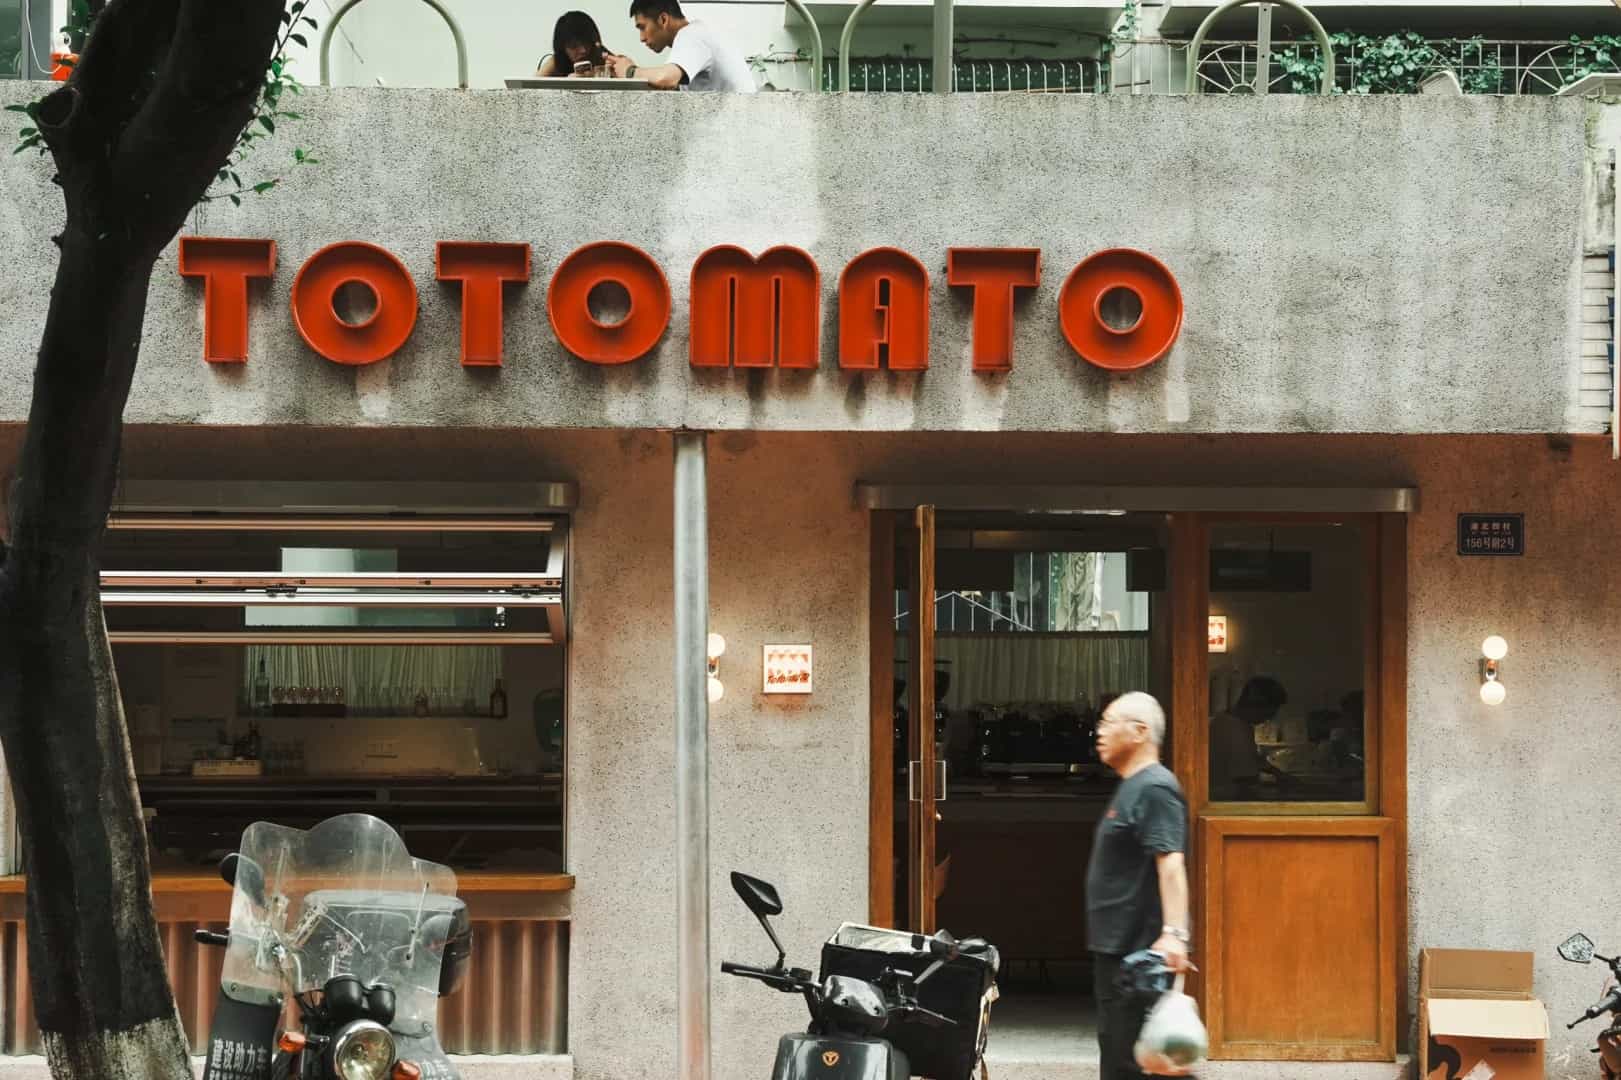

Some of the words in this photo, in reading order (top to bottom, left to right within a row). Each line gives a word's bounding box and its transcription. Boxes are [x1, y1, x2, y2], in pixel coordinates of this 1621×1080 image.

[179, 236, 1184, 371] TOTOMATO
[211, 1038, 268, 1072] 建设助力车
